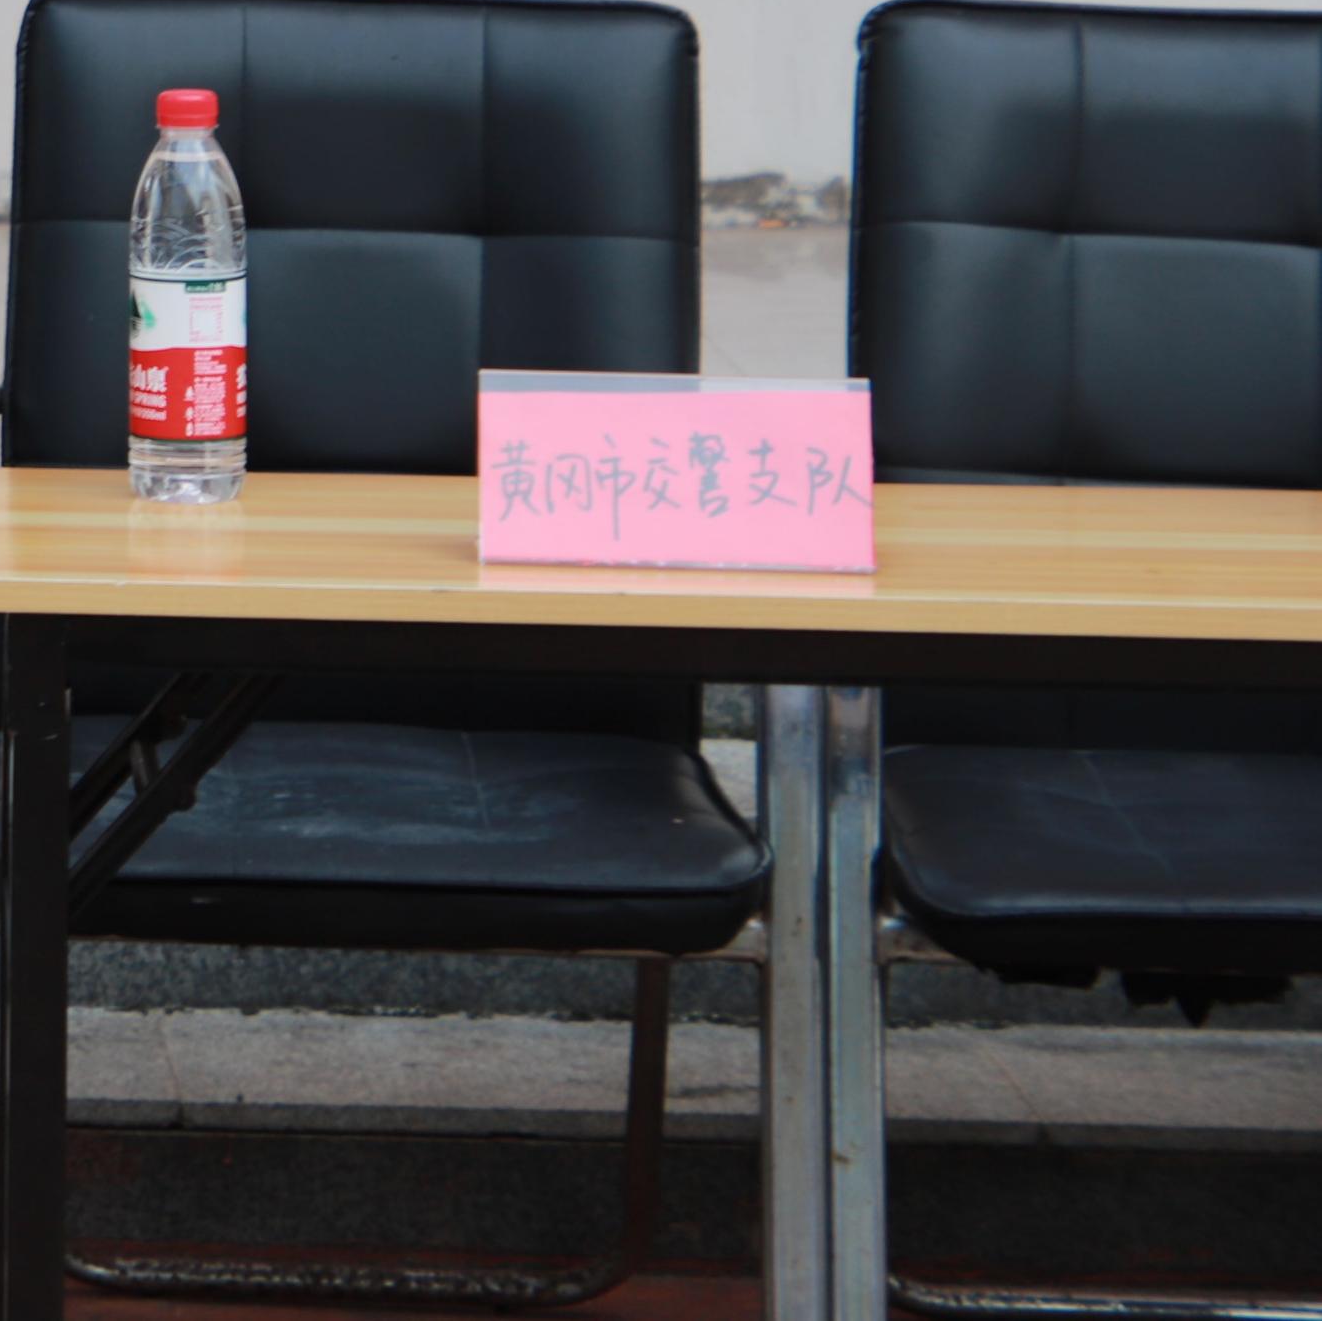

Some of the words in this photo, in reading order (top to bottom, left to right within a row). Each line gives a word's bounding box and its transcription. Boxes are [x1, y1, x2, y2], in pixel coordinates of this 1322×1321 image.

[492, 432, 873, 540] 黄冈市交警支队
